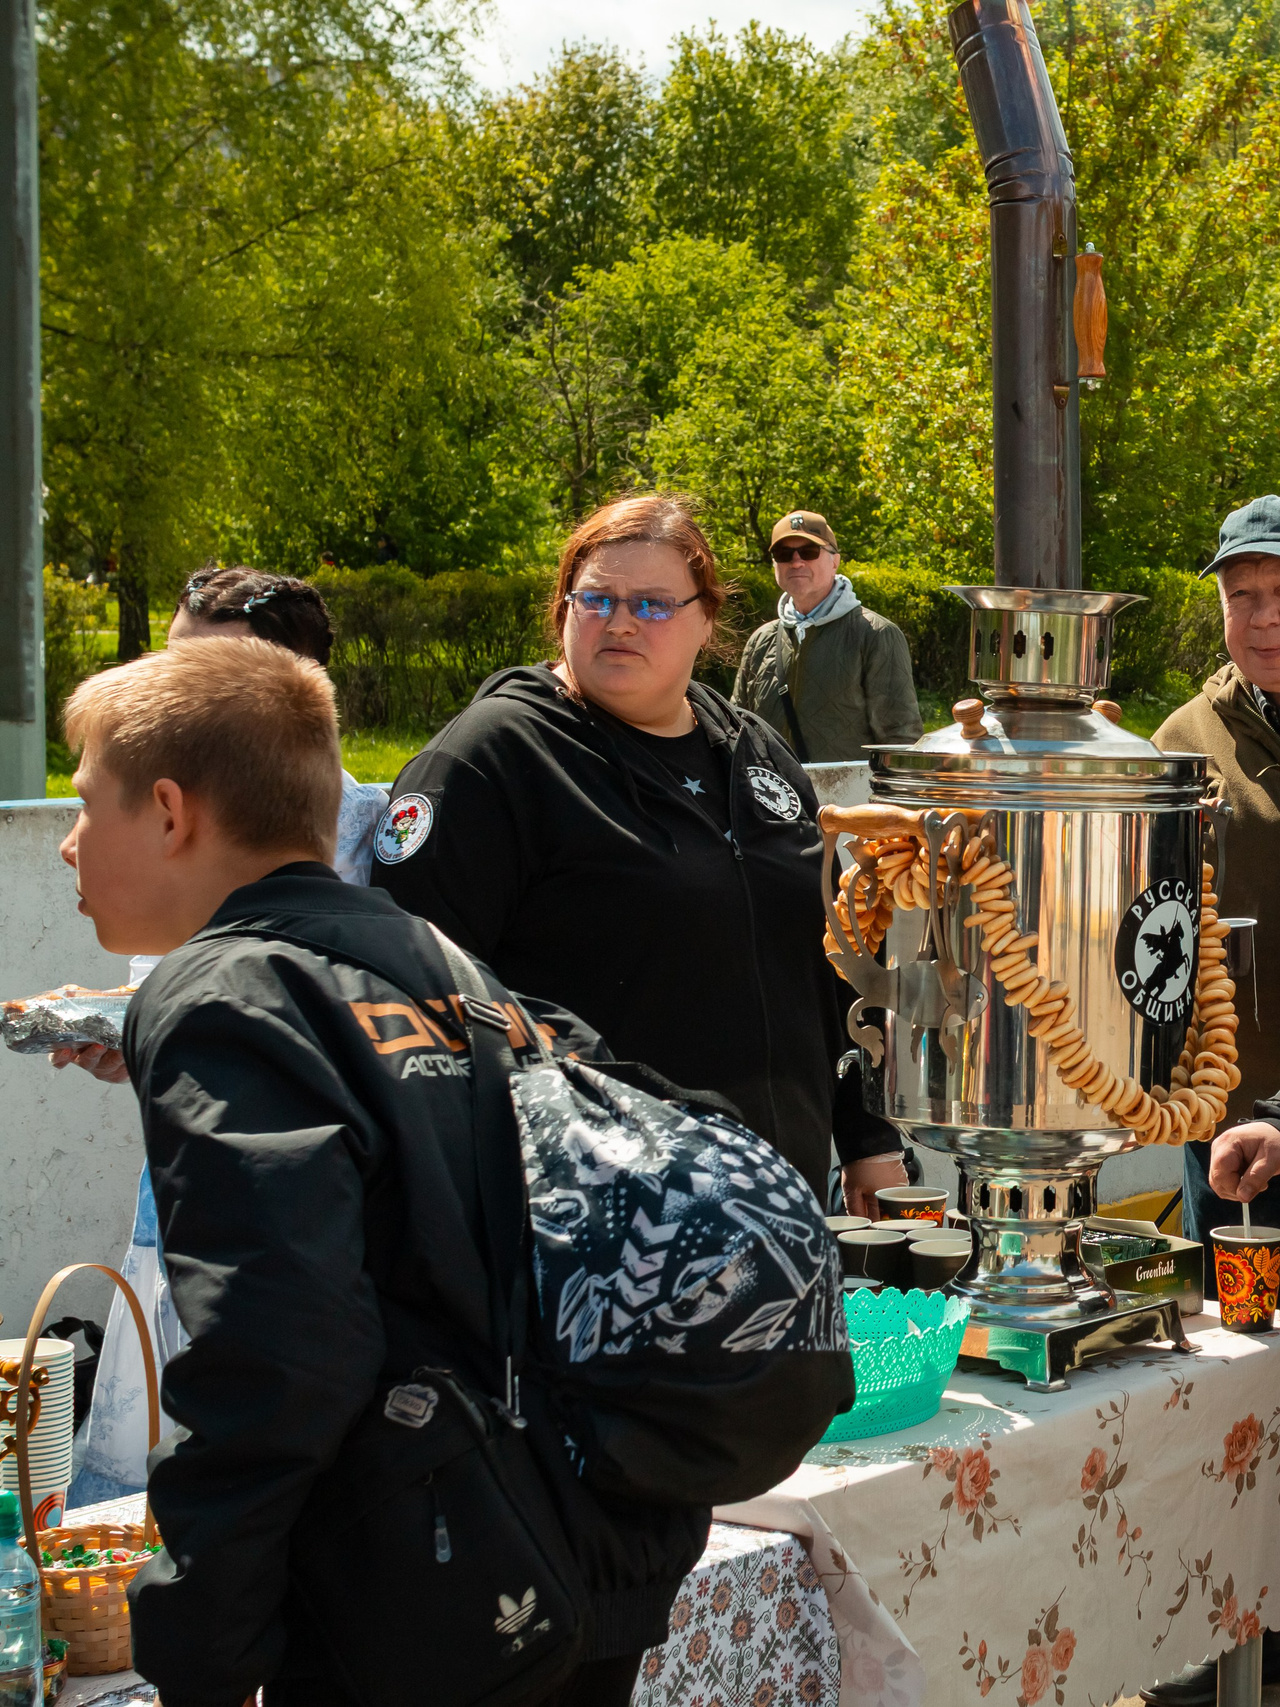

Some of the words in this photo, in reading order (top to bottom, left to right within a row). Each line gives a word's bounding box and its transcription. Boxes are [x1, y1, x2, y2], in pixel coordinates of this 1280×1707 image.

[1131, 880, 1200, 938] РУССКАЯ
[1121, 970, 1193, 1022] ОБЩИНА
[1135, 1259, 1175, 1282] Greenfield
